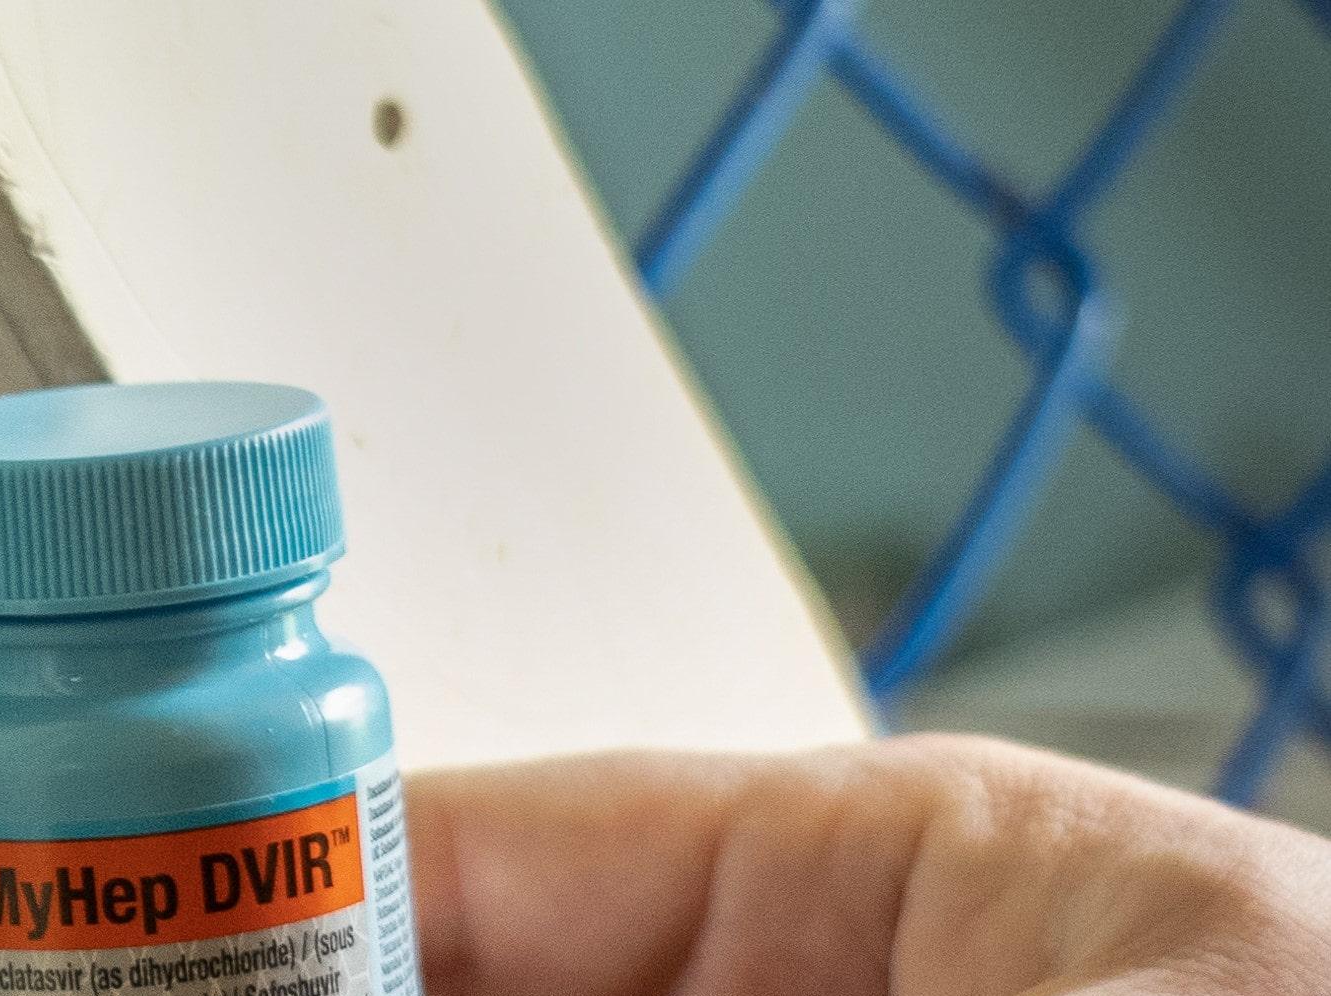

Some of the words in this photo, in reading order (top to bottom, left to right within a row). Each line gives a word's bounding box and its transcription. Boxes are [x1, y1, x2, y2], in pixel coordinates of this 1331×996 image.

[91, 962, 123, 996] (as
[128, 935, 296, 989] dihydrochloride)
[314, 924, 355, 963] (sous
